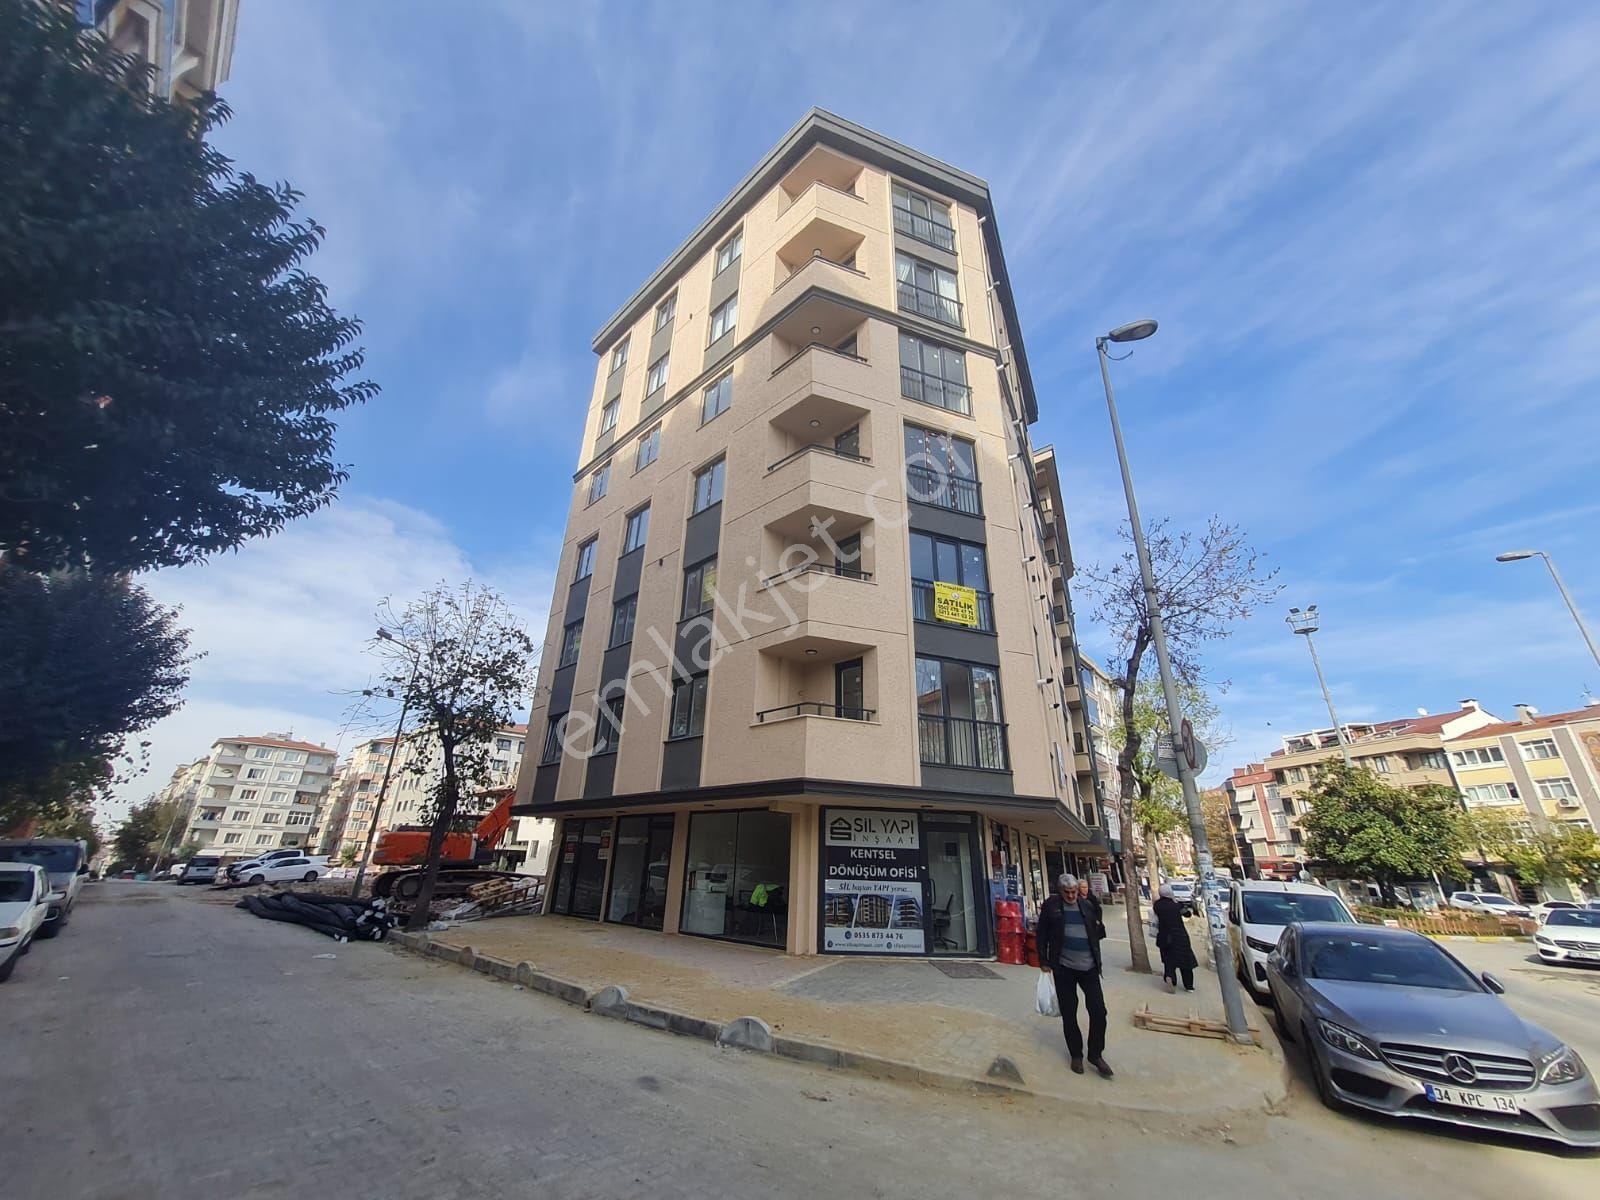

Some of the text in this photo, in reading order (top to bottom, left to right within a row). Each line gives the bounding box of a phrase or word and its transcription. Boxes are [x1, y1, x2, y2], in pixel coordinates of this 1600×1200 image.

[937, 597, 973, 611] SATILIK
[880, 818, 914, 834] YAPI
[850, 848, 897, 860] KENTSEL
[829, 863, 918, 879] DÖNÜŞÜM OFİSİ
[874, 884, 890, 892] YAPI
[1434, 1087, 1451, 1102] 34
[1459, 1092, 1485, 1107] KPC
[1493, 1096, 1516, 1111] 134
